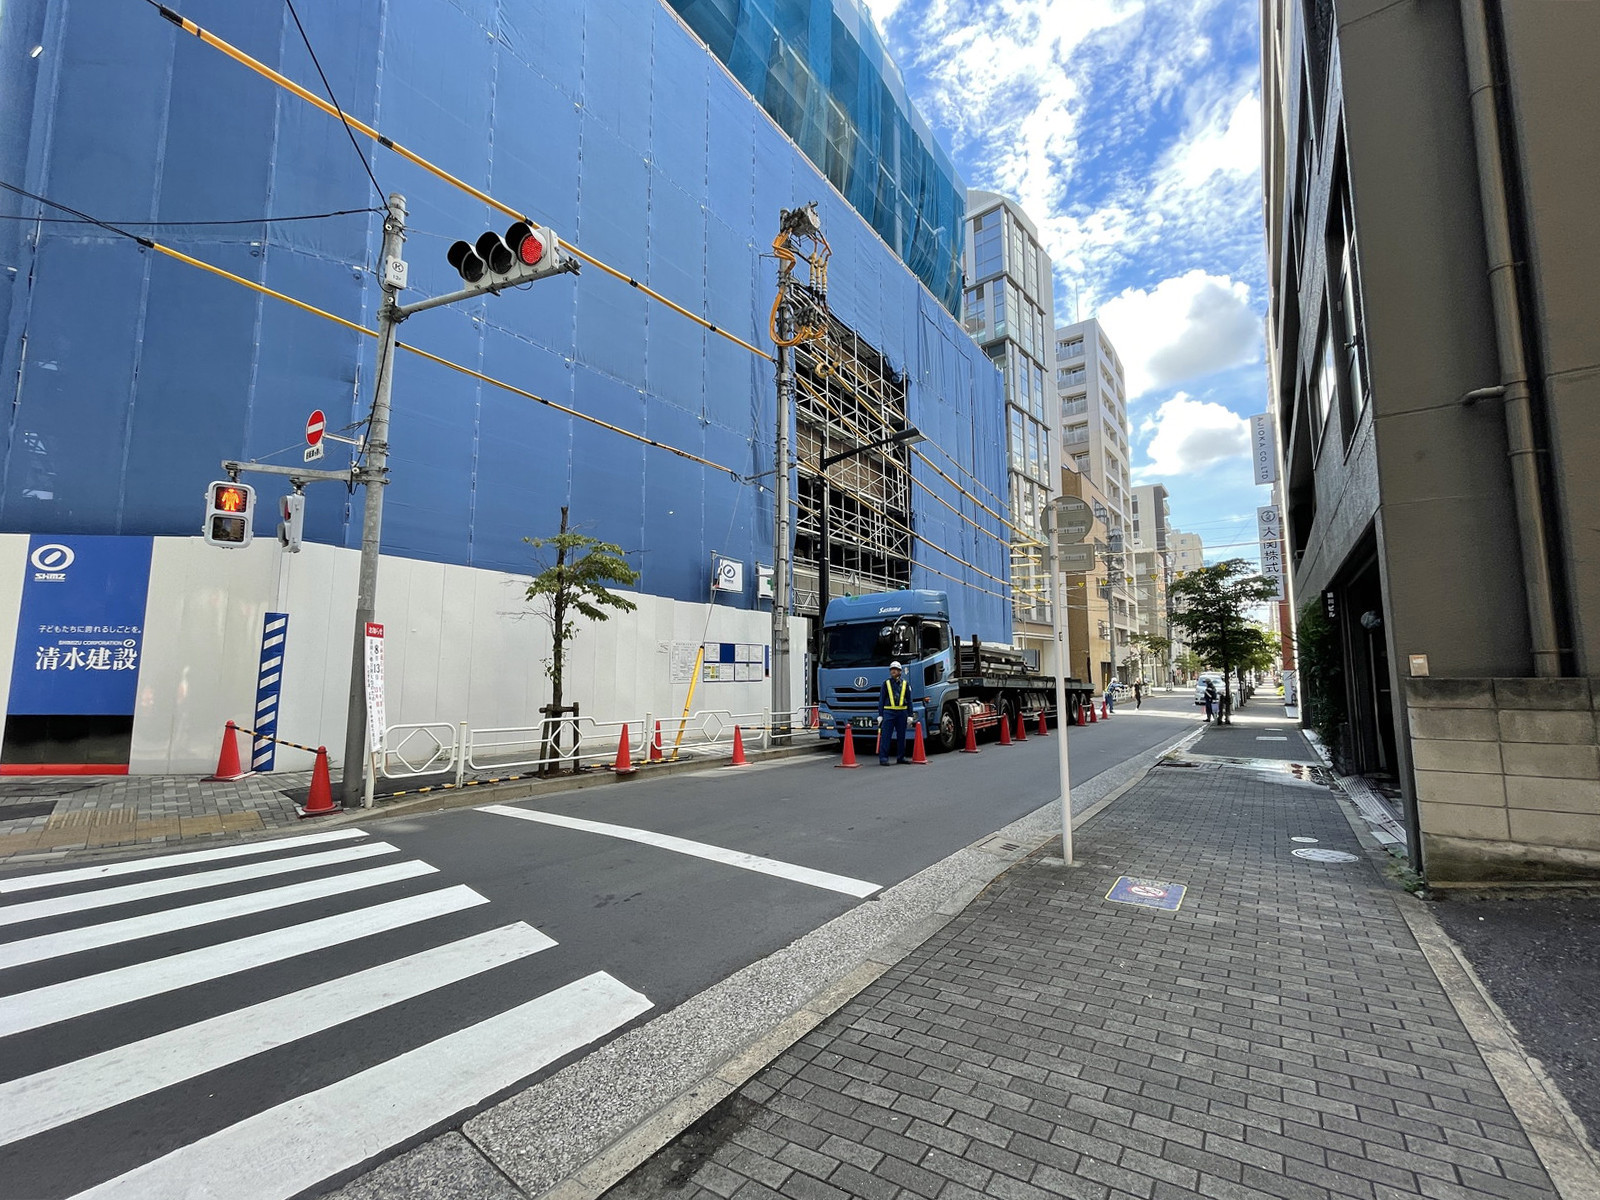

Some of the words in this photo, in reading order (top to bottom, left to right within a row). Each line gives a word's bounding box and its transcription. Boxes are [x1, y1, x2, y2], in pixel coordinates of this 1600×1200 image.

[38, 624, 142, 634] 子どもたちに誇れるしごとを。
[35, 646, 138, 671] 清水建設
